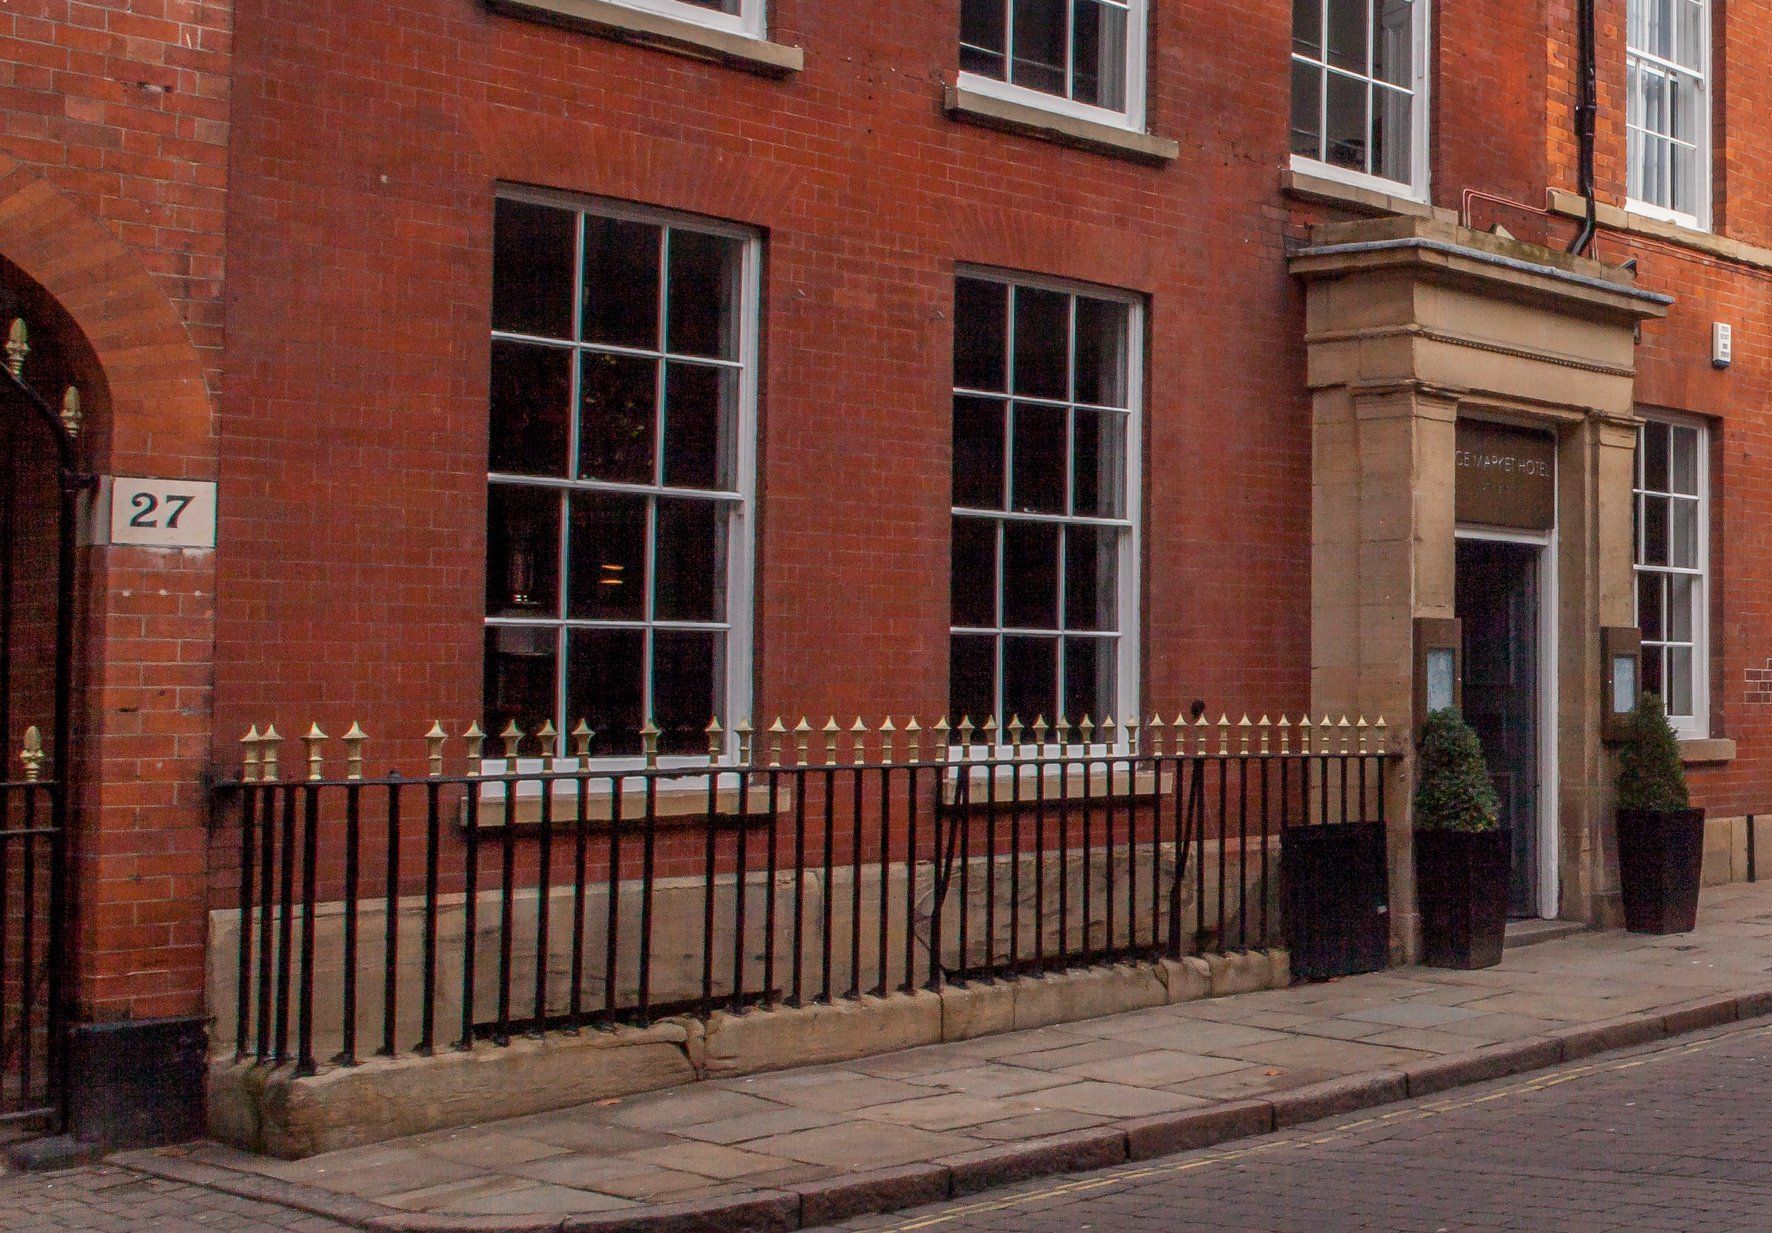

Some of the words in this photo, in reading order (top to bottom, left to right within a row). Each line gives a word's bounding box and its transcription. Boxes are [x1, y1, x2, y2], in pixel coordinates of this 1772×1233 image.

[1473, 454, 1516, 472] MARKET
[1518, 460, 1551, 477] HOTEL
[129, 492, 196, 528] 27
